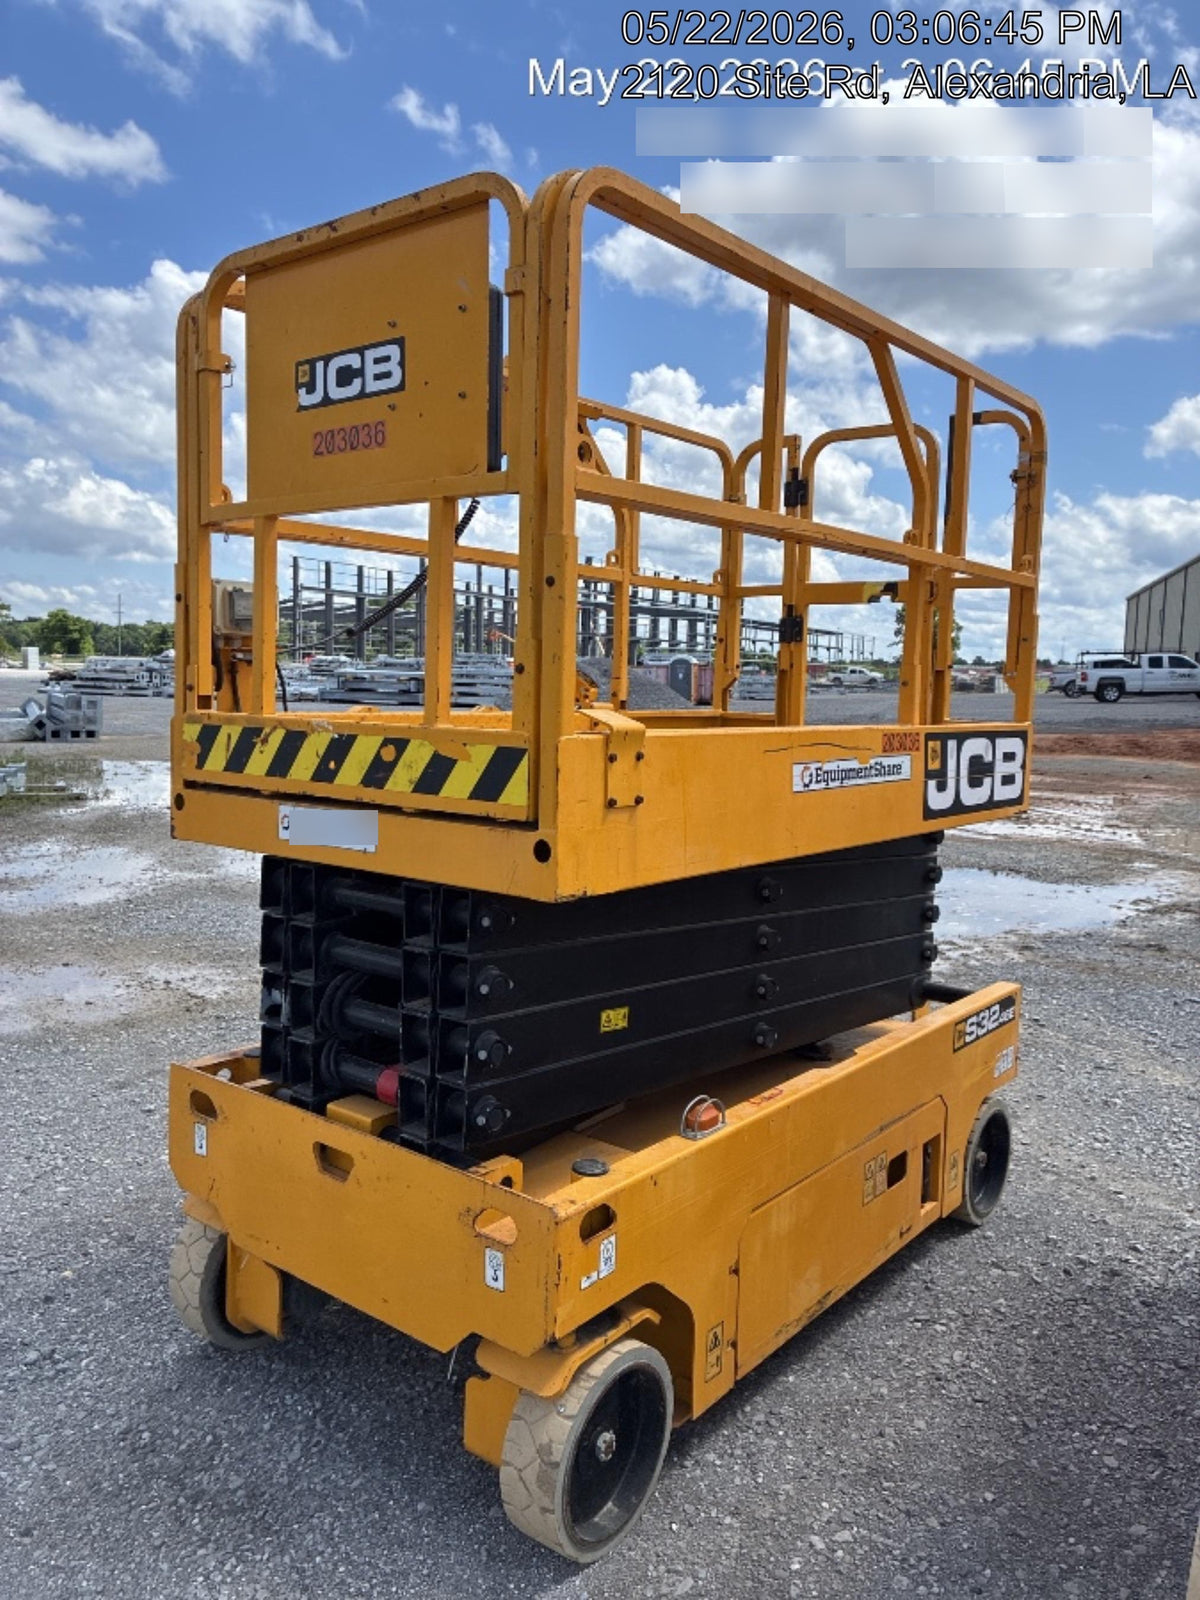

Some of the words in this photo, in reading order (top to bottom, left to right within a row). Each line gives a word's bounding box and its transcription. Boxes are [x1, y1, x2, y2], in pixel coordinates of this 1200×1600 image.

[298, 344, 402, 407] JCB
[313, 421, 386, 456] 203036
[814, 761, 902, 786] EquipmentShare
[927, 737, 1024, 810] JCB
